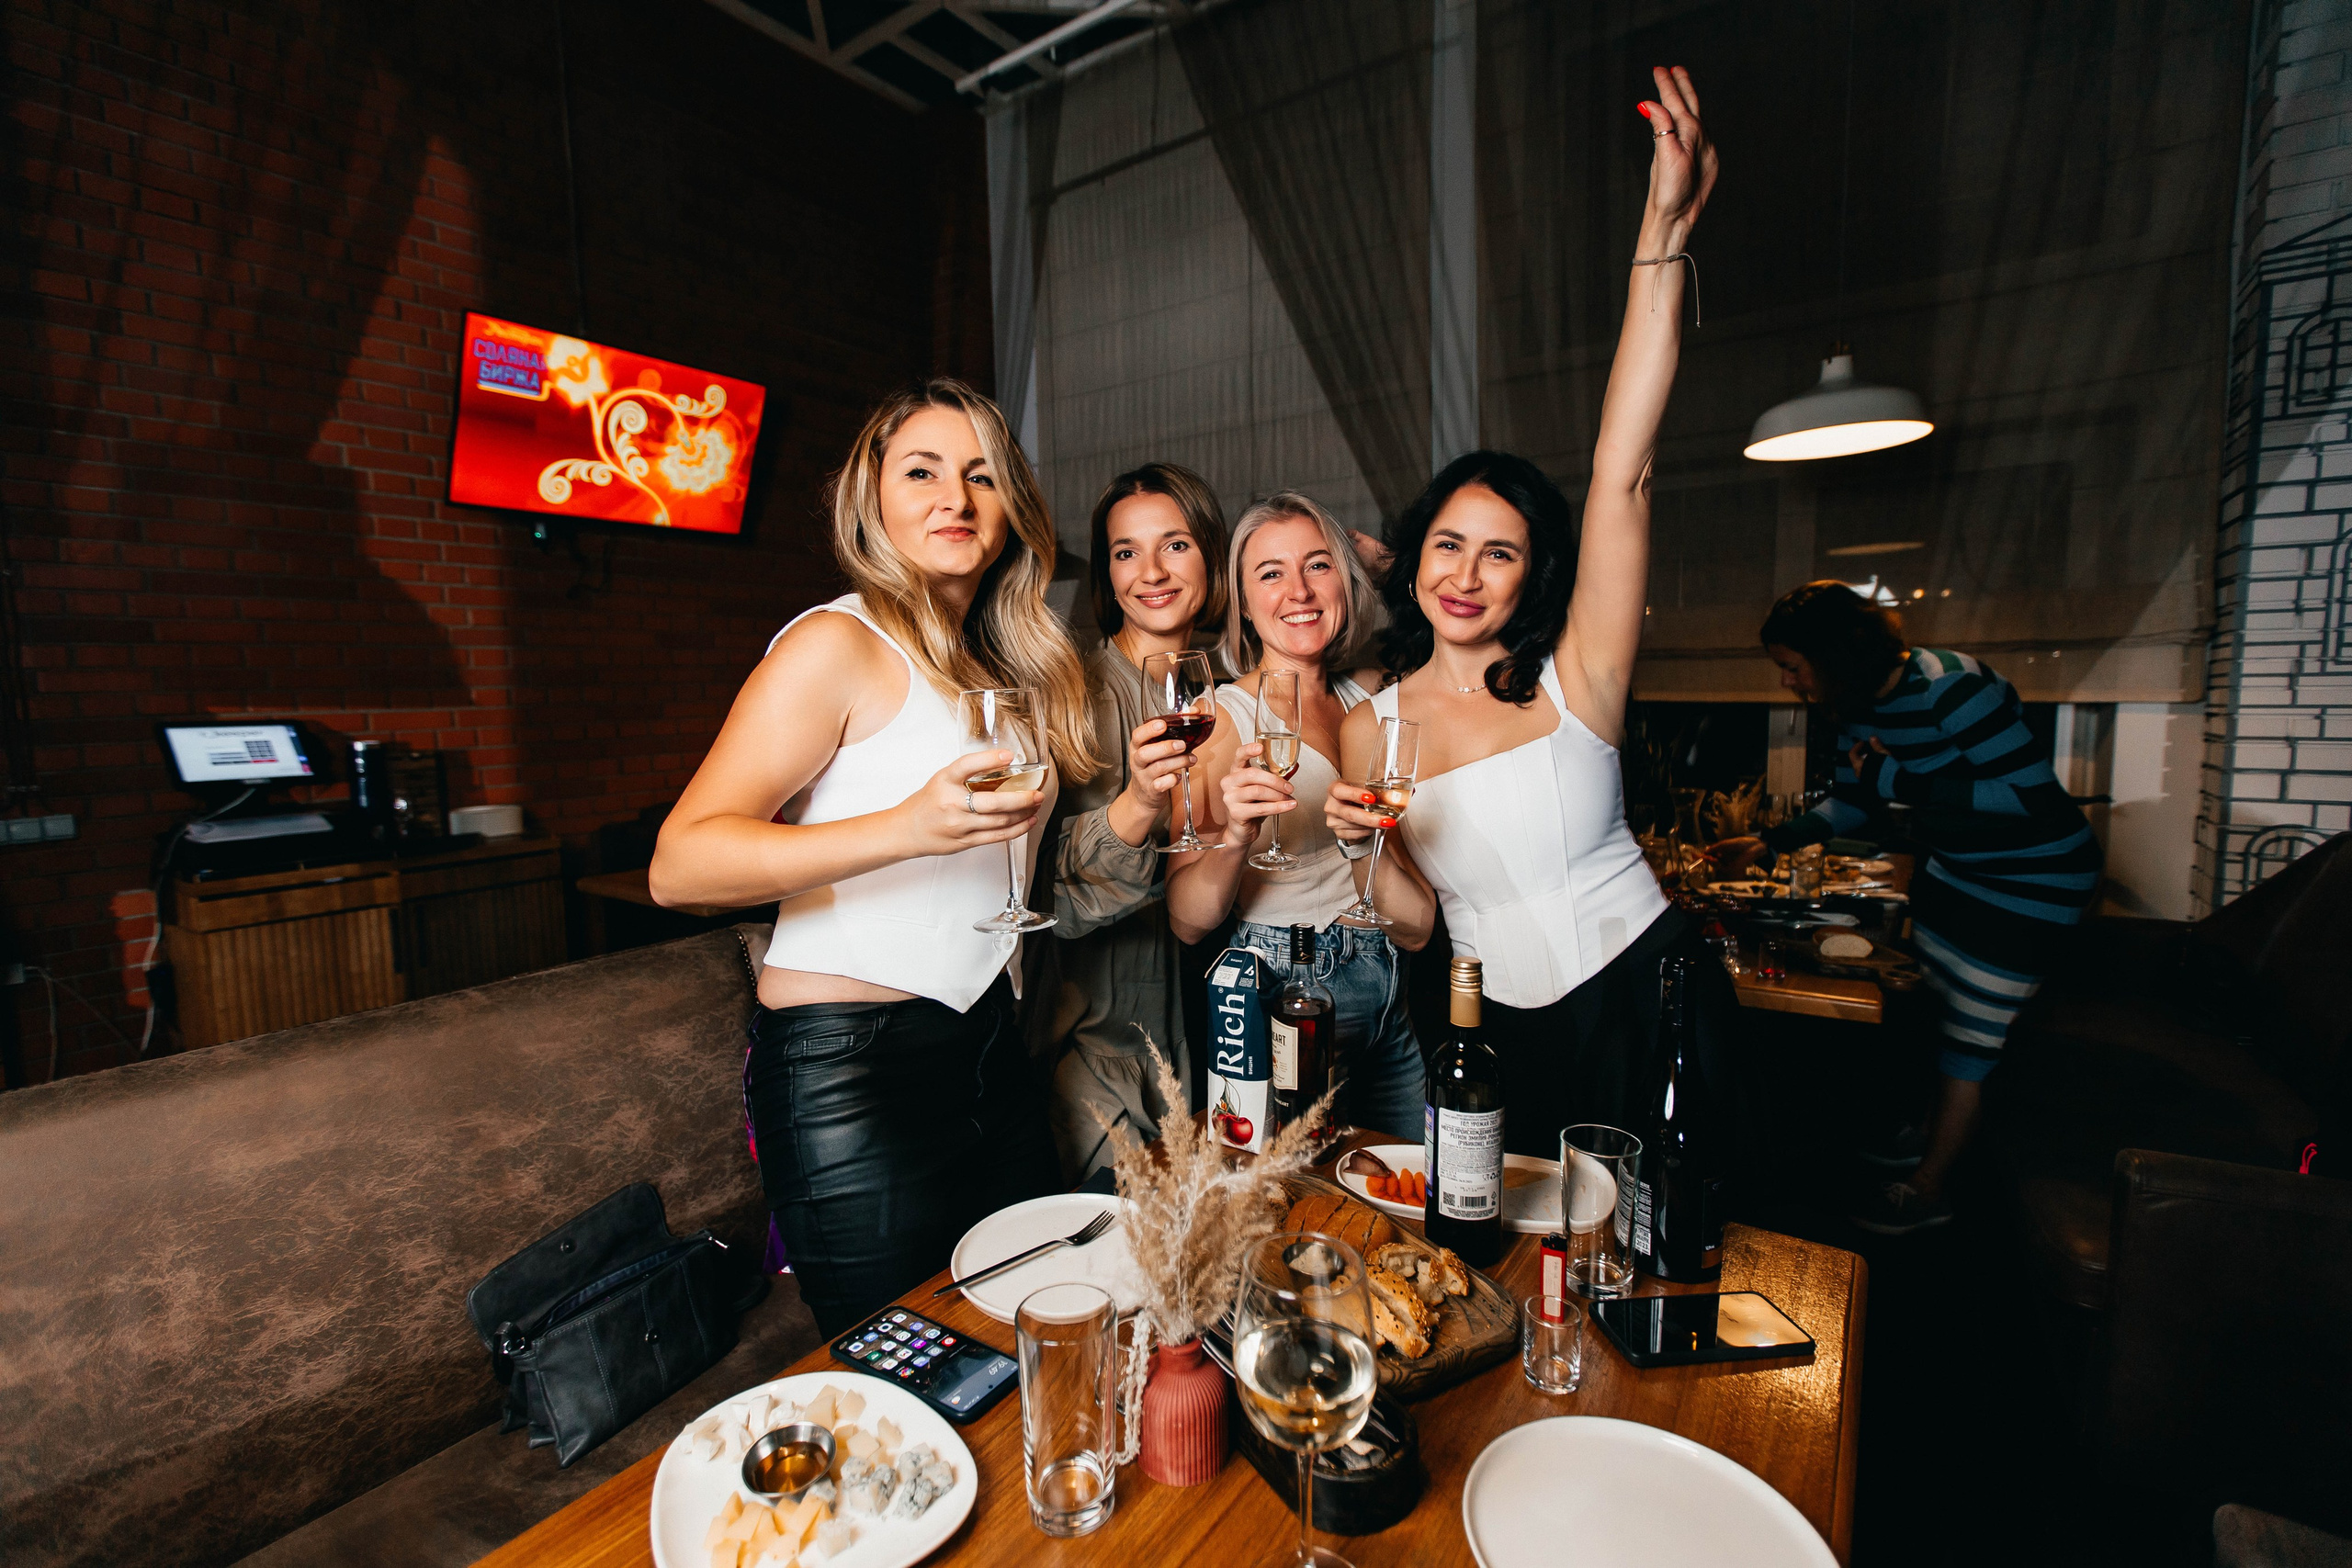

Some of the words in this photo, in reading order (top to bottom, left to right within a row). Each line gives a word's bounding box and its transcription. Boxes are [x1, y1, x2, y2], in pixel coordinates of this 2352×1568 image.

[480, 360, 539, 389] БИРЖА
[1216, 994, 1246, 1077] Rich
[1272, 1031, 1286, 1046] EART
